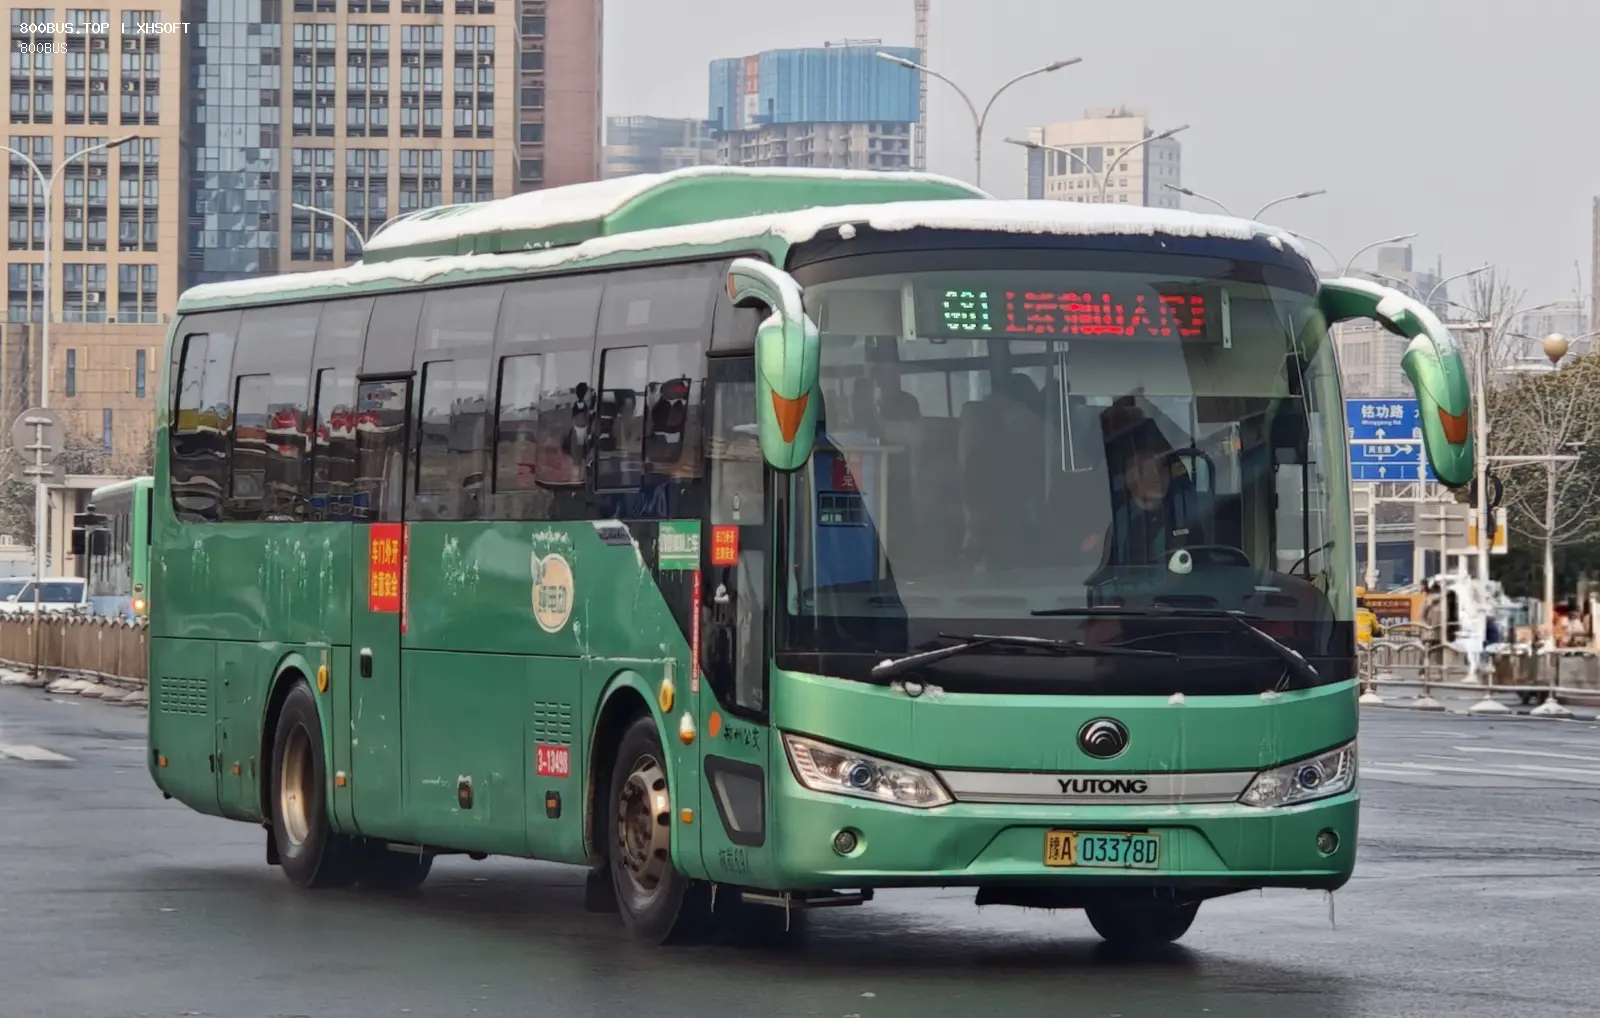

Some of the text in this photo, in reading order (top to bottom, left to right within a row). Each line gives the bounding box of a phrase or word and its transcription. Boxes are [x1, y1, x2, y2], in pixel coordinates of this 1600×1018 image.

[1361, 404, 1403, 419] 铭功路
[371, 538, 398, 564] 车门外开
[371, 570, 398, 597] 注意安全
[1057, 779, 1148, 793] YUTONG
